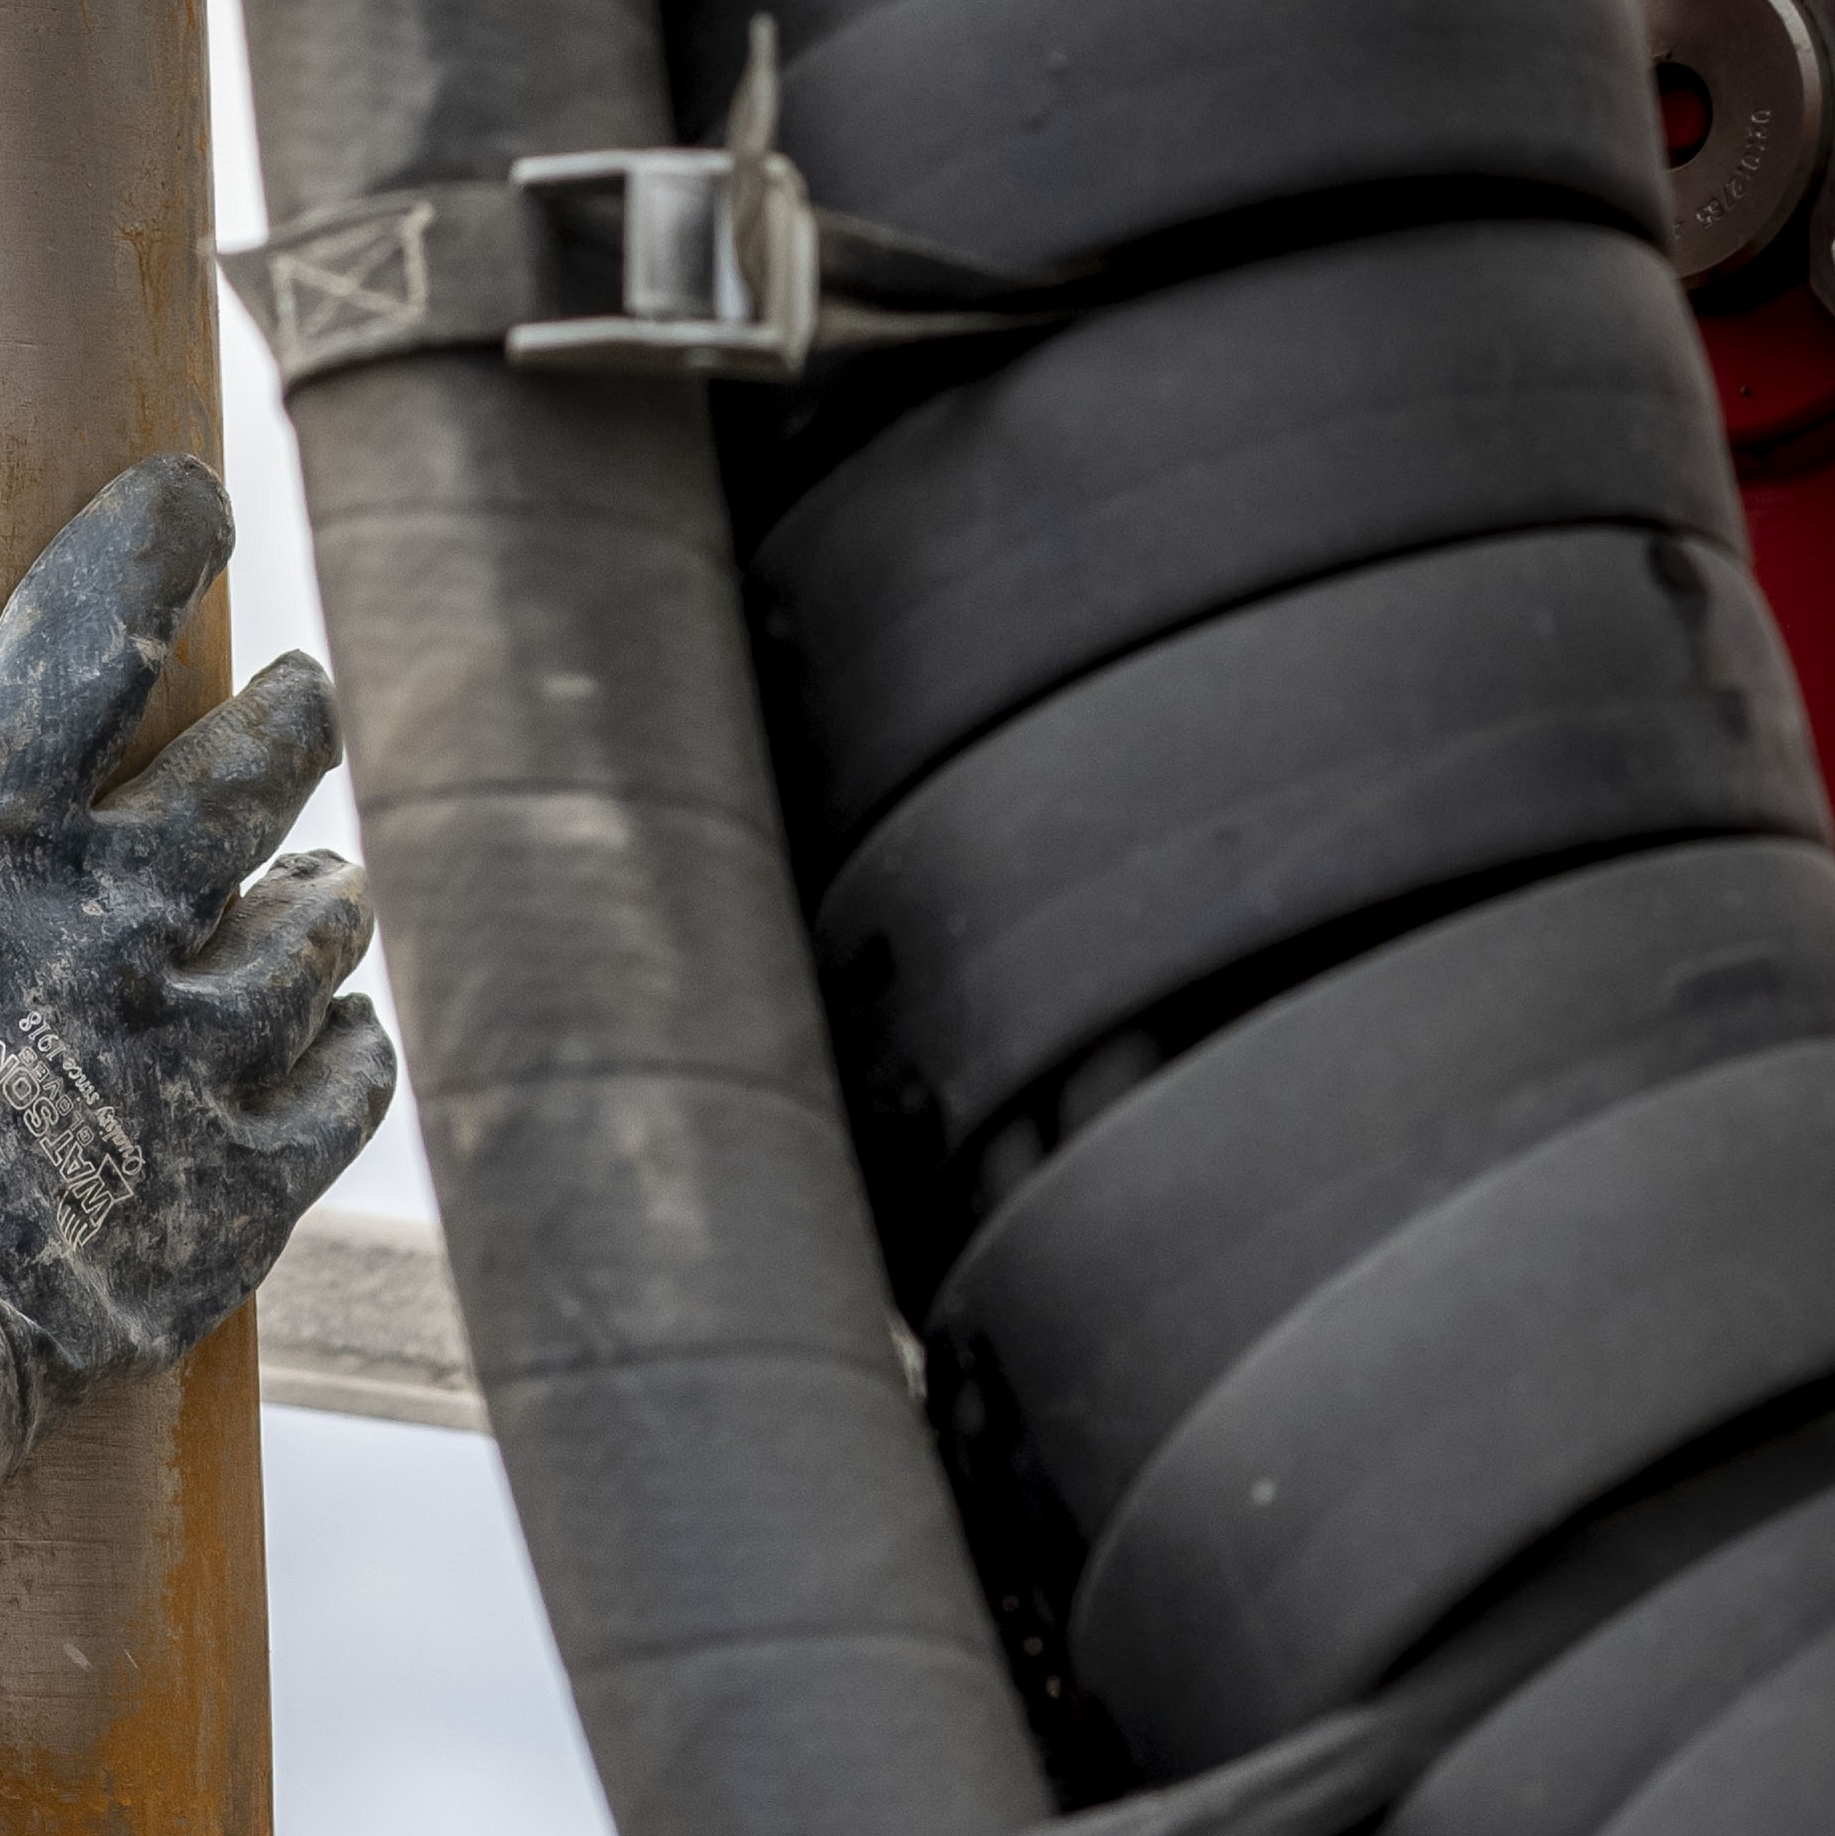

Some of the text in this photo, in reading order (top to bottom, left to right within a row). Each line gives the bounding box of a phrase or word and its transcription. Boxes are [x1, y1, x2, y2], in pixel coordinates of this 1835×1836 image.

[18, 1011, 145, 1175] Quality since 1918
[19, 1046, 94, 1147] GLOVES
